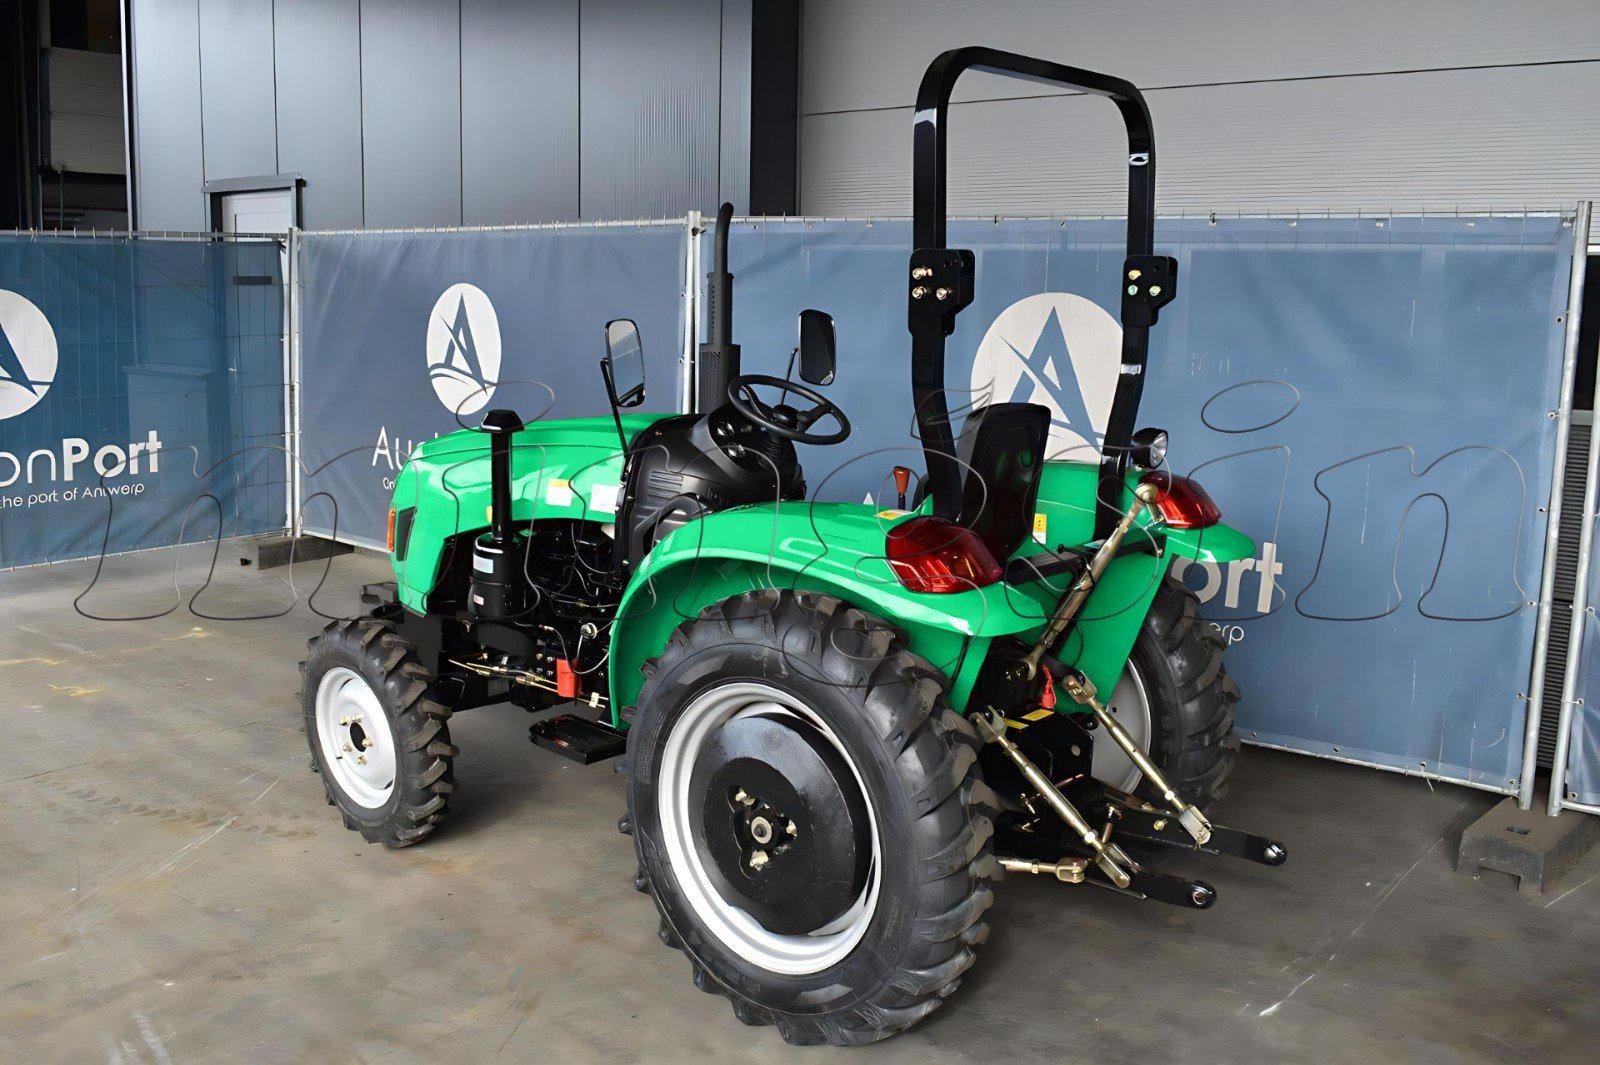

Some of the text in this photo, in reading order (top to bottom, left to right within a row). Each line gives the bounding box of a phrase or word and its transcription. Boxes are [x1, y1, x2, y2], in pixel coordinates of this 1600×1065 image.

[0, 483, 145, 509] he port of Antwerp
